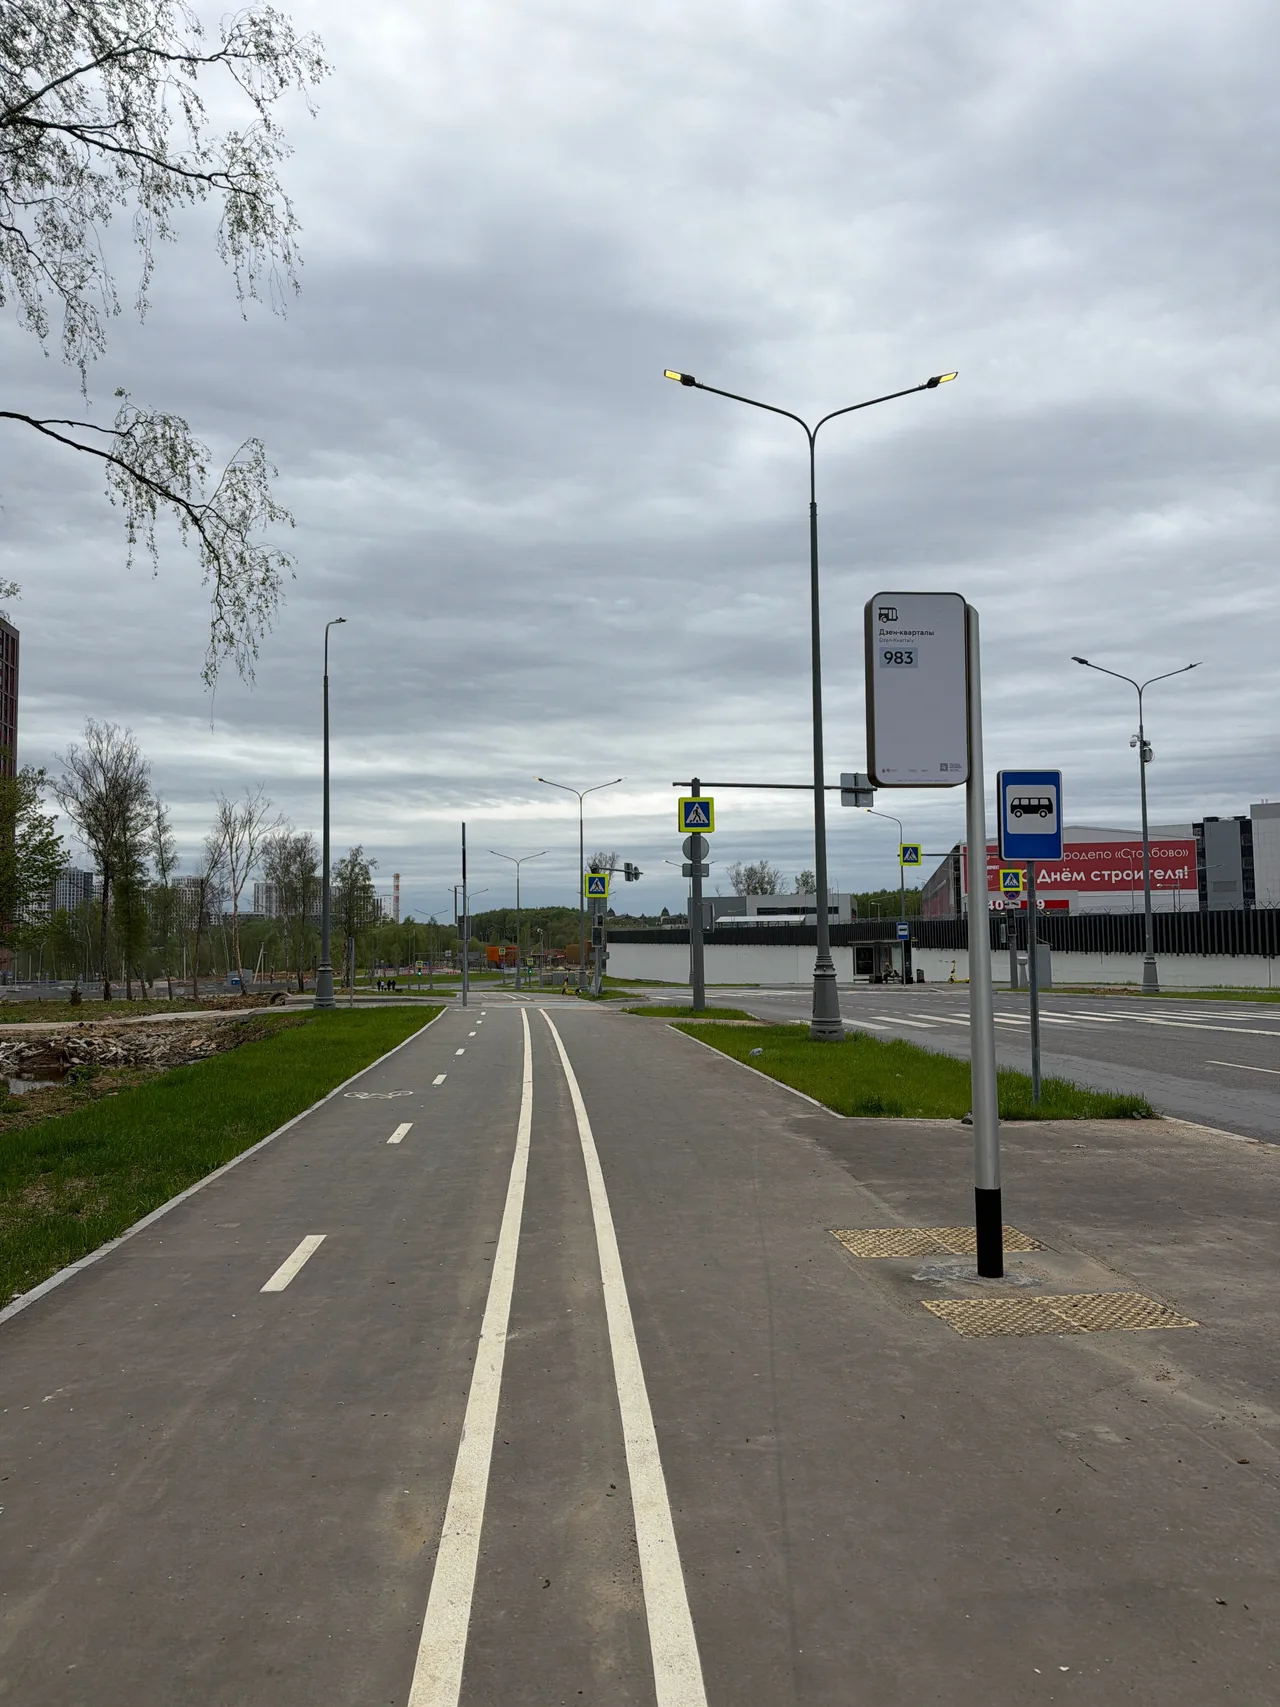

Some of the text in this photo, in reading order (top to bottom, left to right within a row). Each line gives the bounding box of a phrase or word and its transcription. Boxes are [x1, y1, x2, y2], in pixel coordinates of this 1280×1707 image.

[879, 629, 934, 637] Дзен-кварталы
[884, 651, 913, 665] 983
[1037, 868, 1086, 884] Днём
